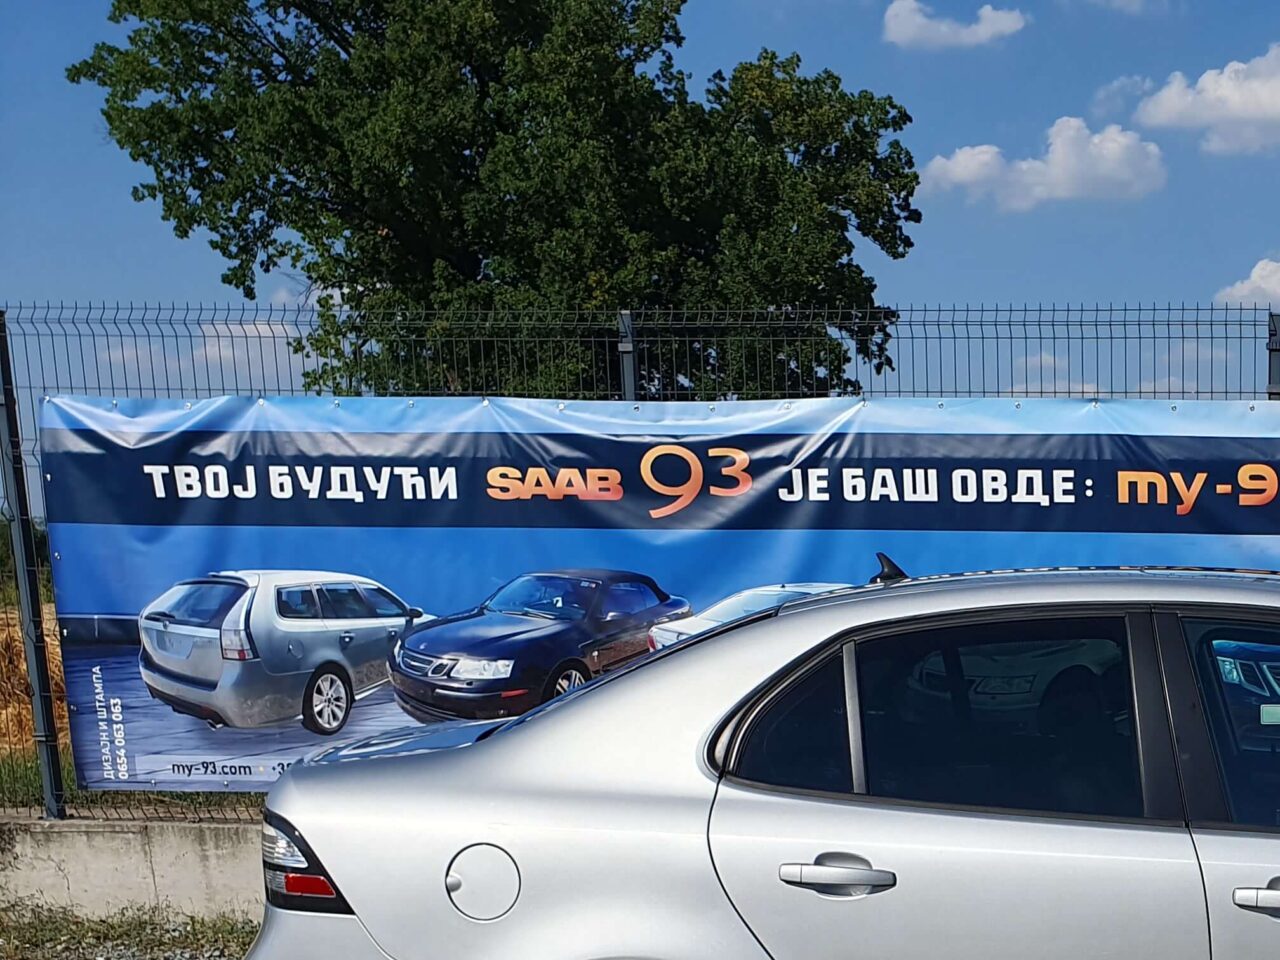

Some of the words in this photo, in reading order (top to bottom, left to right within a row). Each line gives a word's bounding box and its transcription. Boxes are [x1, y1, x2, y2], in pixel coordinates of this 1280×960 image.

[143, 464, 257, 499] ТВОЈ
[486, 466, 624, 501] SAAB
[640, 444, 753, 519] 93
[778, 467, 830, 502] ЈЕ
[842, 467, 939, 502] БАШ
[91, 665, 108, 719] ШТАМПА
[98, 721, 109, 730] И
[110, 697, 123, 722] 063
[112, 723, 125, 747] 063
[99, 732, 115, 780] ДИЗАЈН
[115, 748, 129, 780] 0654
[171, 761, 252, 777] my-93.com
